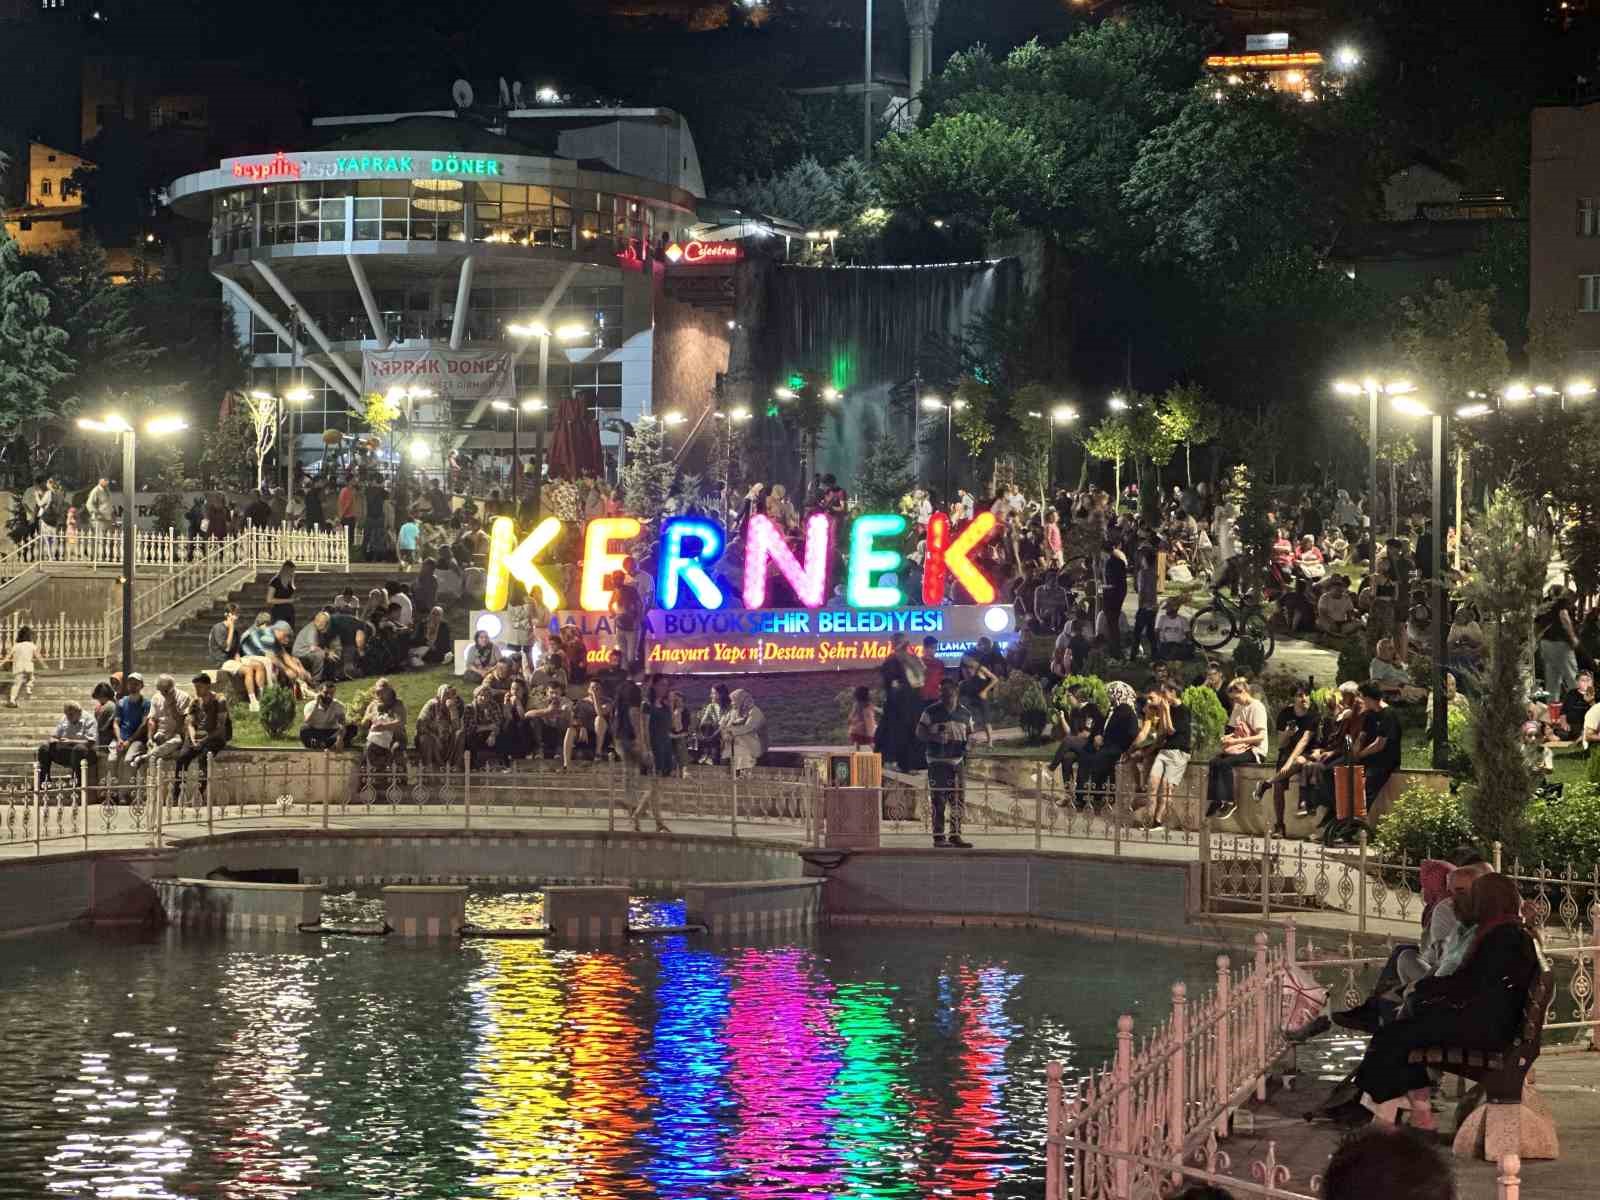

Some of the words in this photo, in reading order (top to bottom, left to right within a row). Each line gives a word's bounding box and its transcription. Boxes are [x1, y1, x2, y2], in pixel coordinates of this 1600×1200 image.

[336, 156, 413, 173] YAPRAK
[431, 155, 499, 175] DÖNER
[485, 511, 997, 611] KERNEK
[818, 610, 943, 632] BELEDİYESİ
[648, 644, 710, 664] Anayurt
[763, 642, 815, 660] Destan
[818, 641, 857, 663] Şehri
